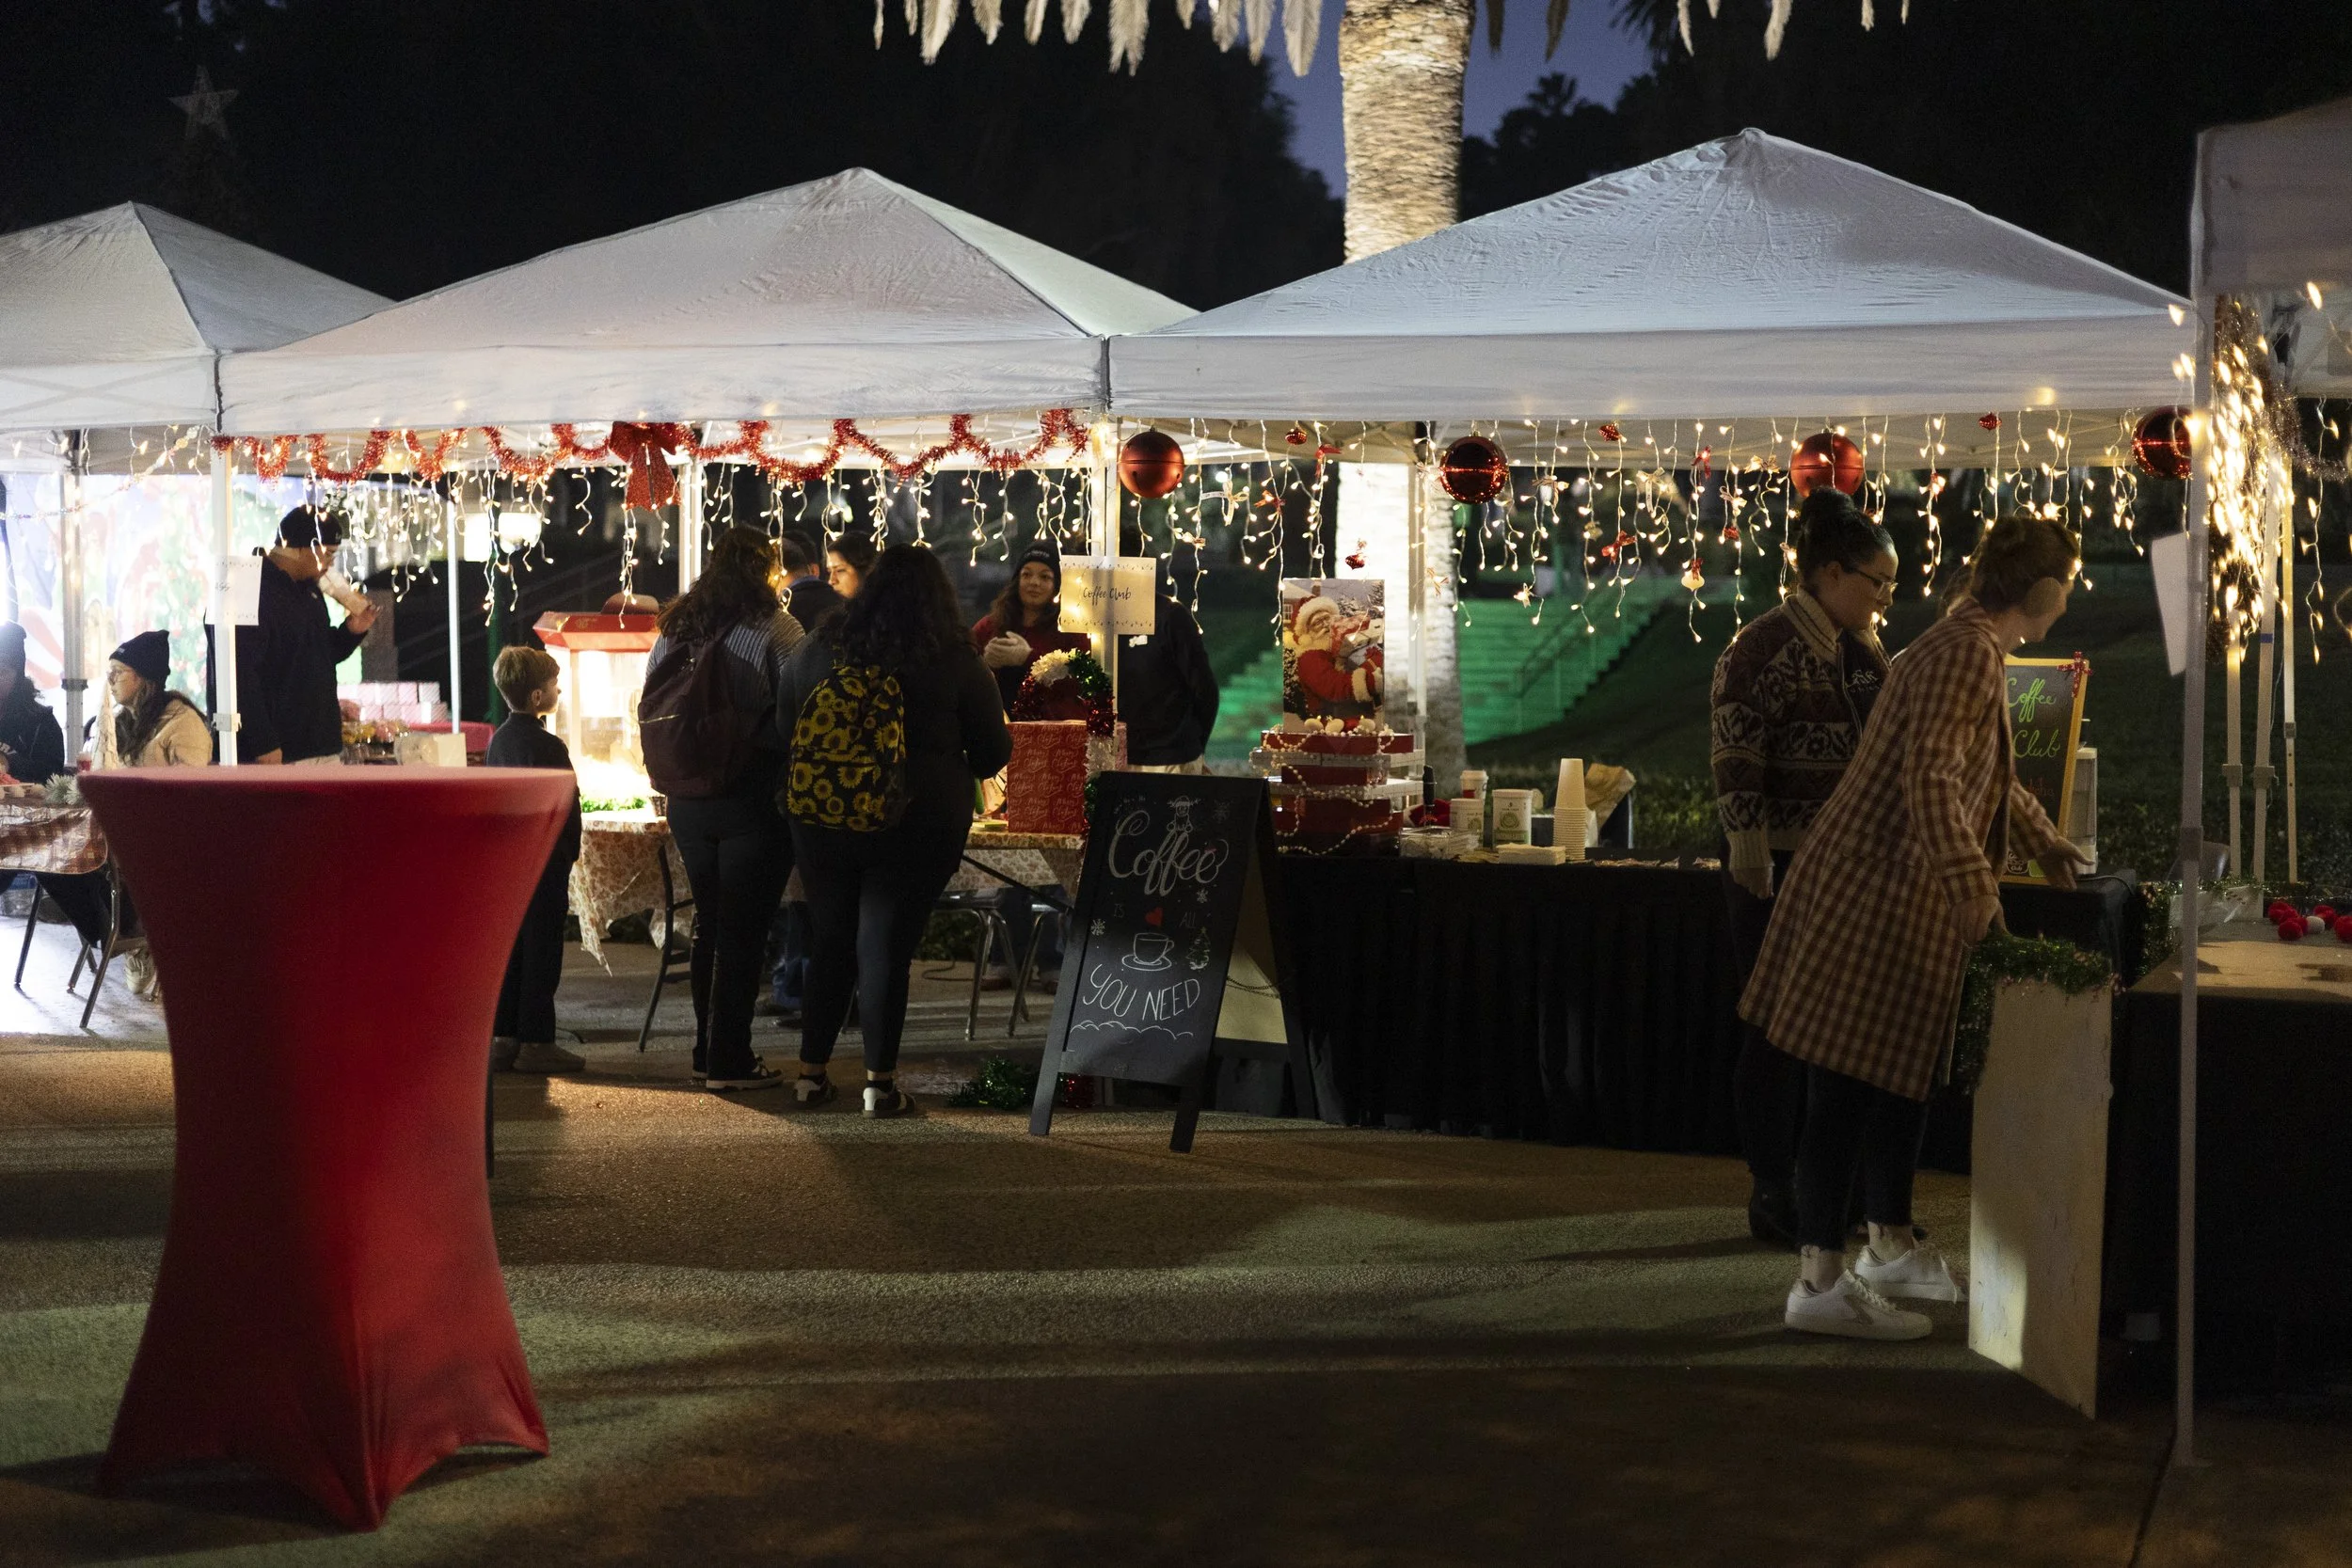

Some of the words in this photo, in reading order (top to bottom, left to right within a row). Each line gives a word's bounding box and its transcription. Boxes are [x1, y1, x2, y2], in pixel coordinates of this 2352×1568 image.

[1083, 586, 1107, 606] Coffee
[1109, 587, 1132, 600] Club
[2012, 728, 2061, 758] Club
[1108, 810, 1230, 896] Coffee
[1083, 963, 1137, 1017] YOU
[1142, 978, 1200, 1021] NEED
